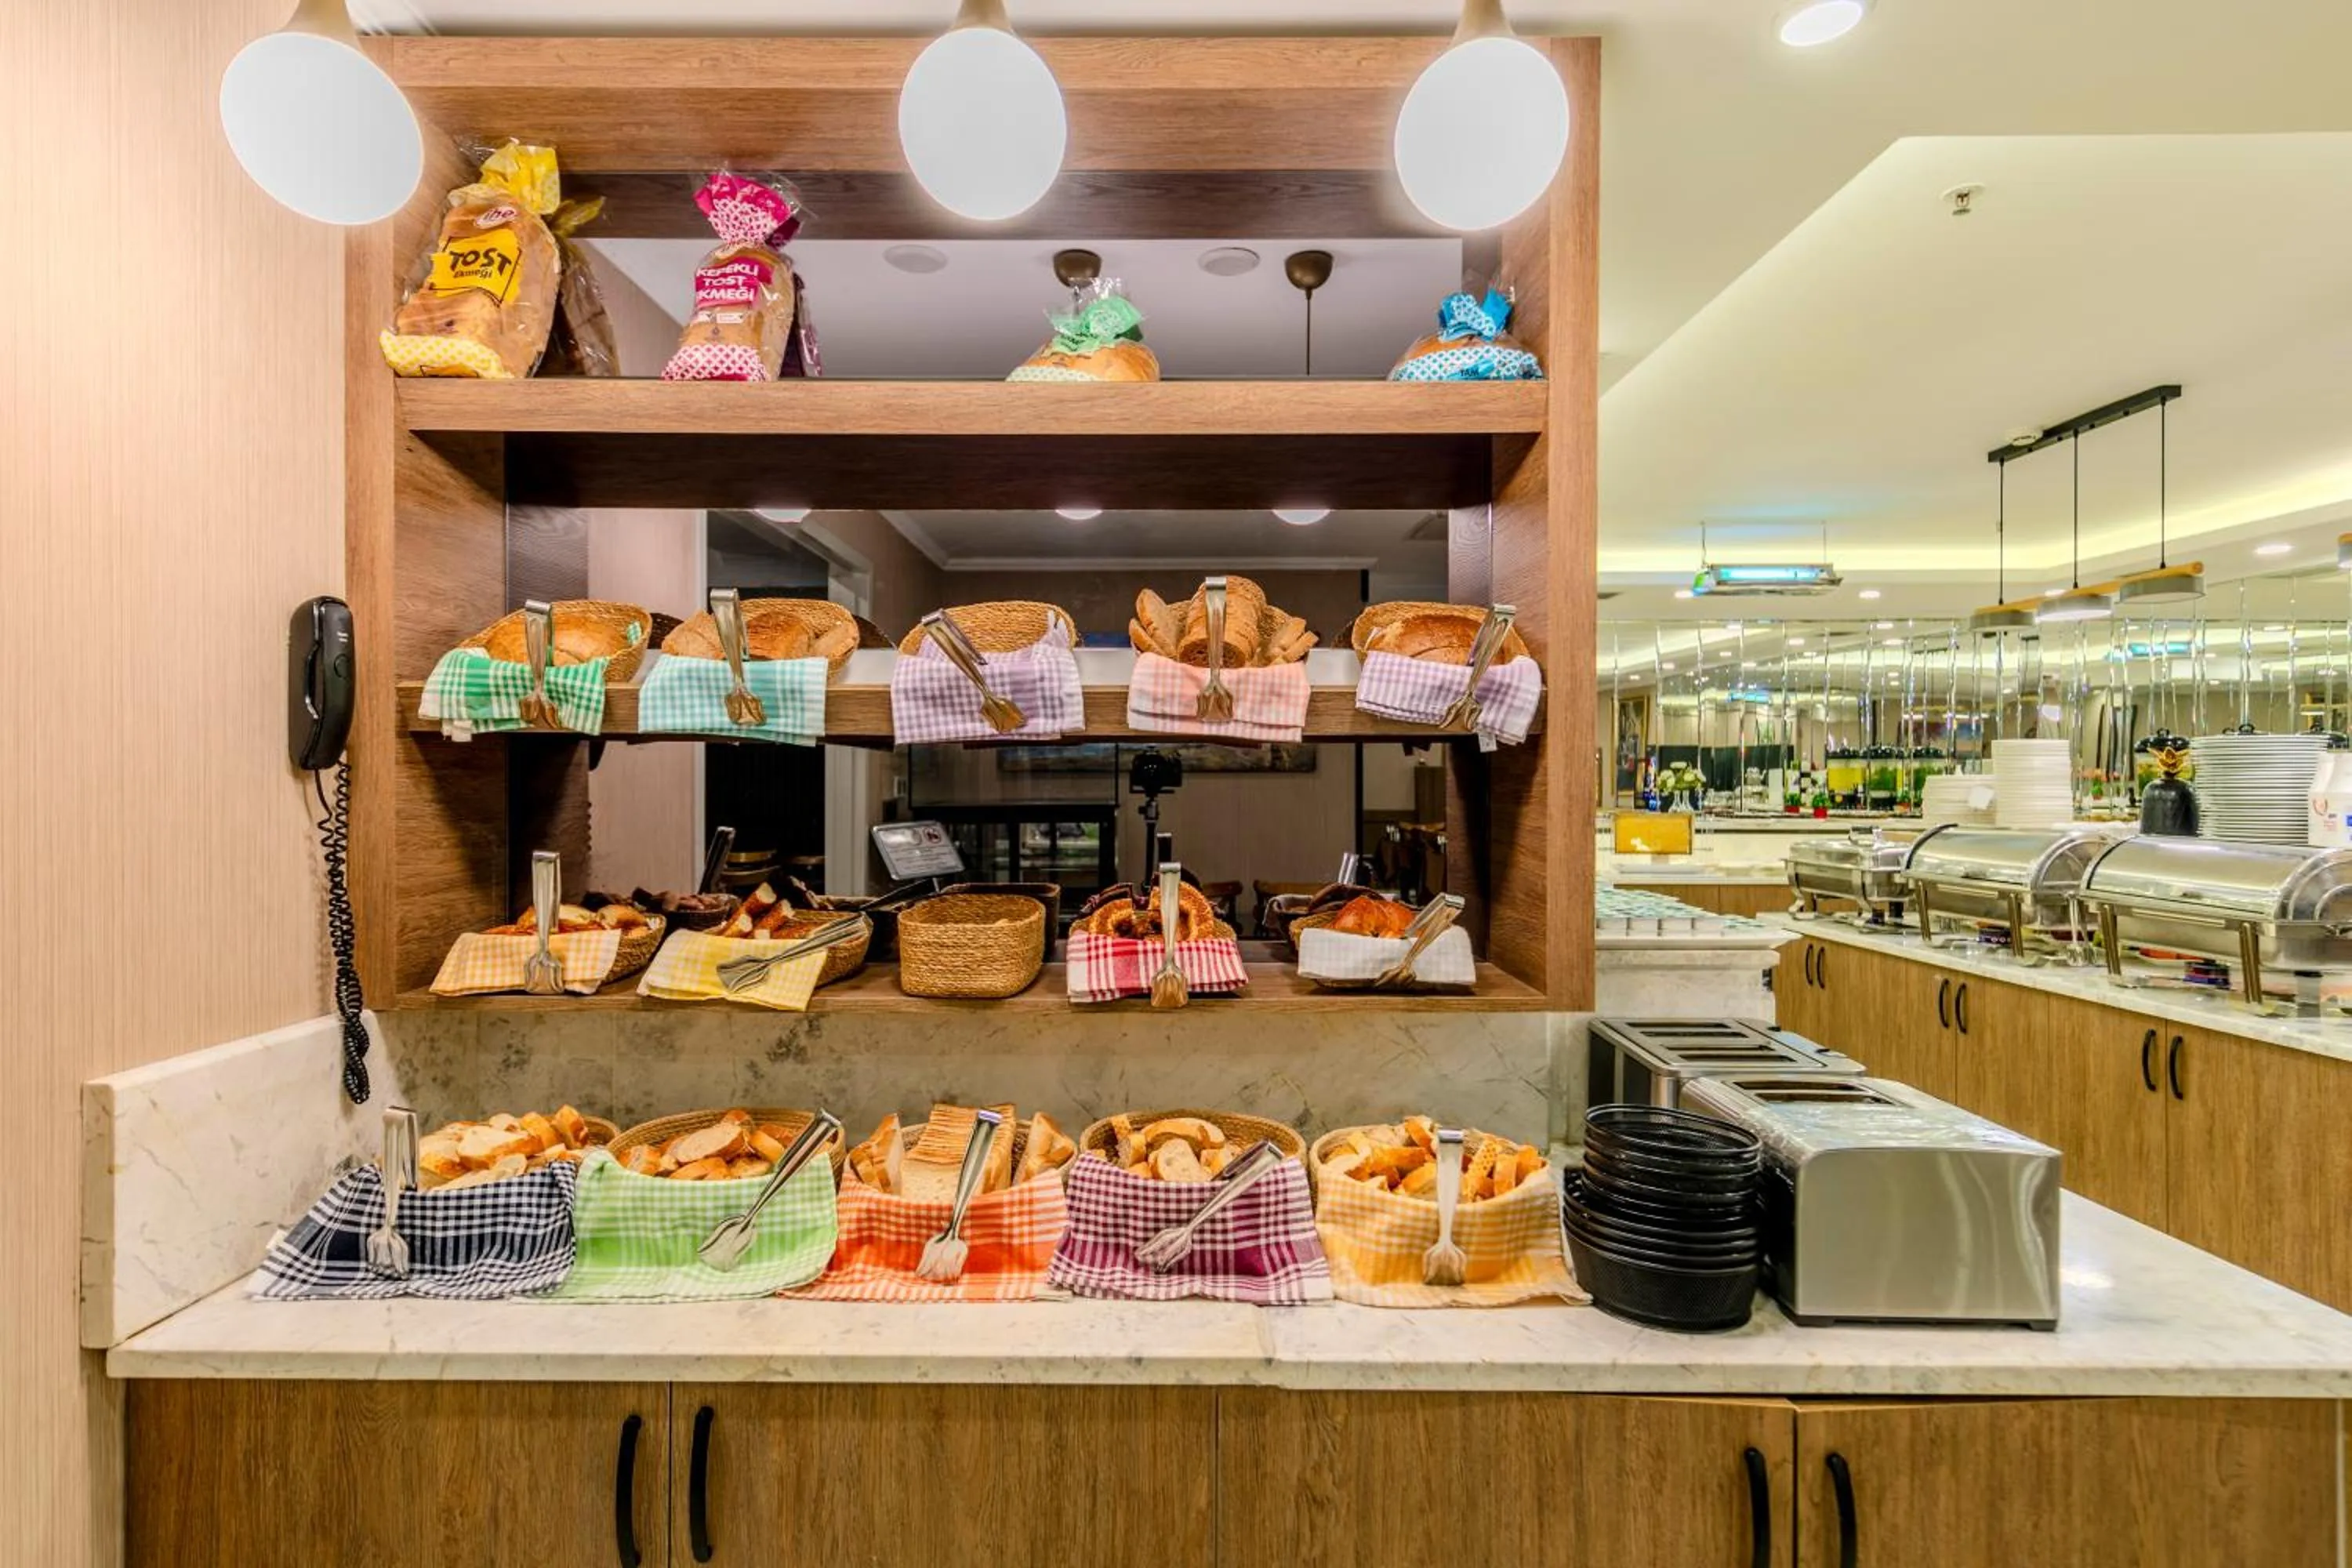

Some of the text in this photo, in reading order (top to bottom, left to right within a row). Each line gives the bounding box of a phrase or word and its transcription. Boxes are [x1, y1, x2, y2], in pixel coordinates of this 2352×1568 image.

[449, 248, 512, 276] TOST
[703, 275, 747, 286] TOST
[696, 286, 755, 302] KMEĞİ
